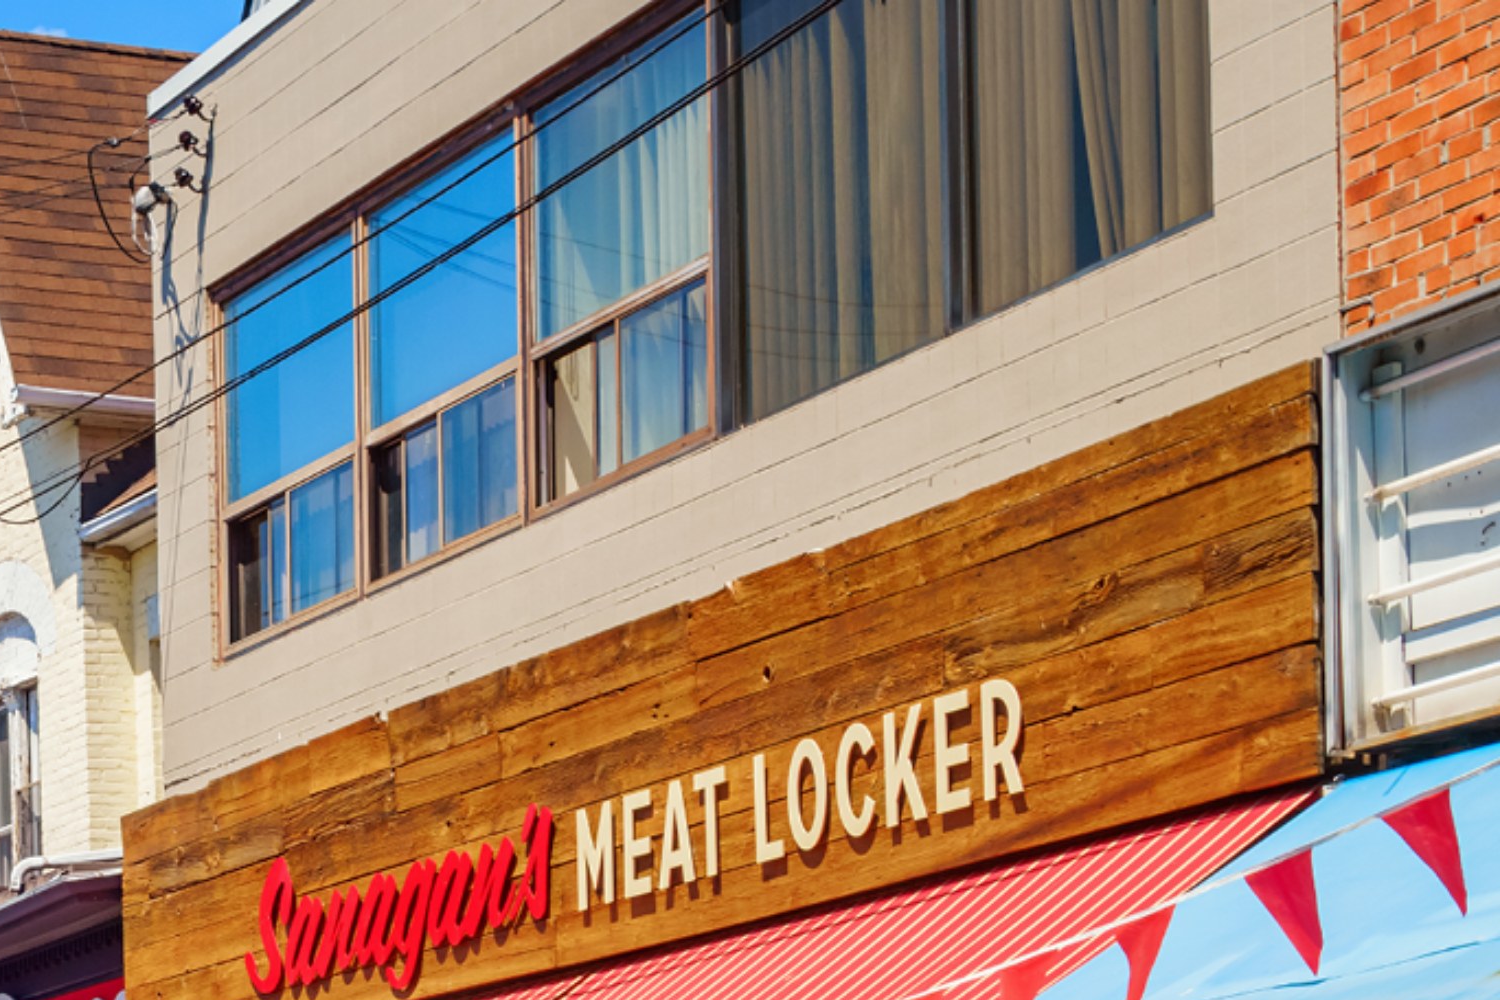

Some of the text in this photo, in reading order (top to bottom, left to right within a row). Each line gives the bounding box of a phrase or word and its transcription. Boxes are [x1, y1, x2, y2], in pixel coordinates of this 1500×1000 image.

[245, 678, 1026, 994] Sanagan's MEAT LOCKER
